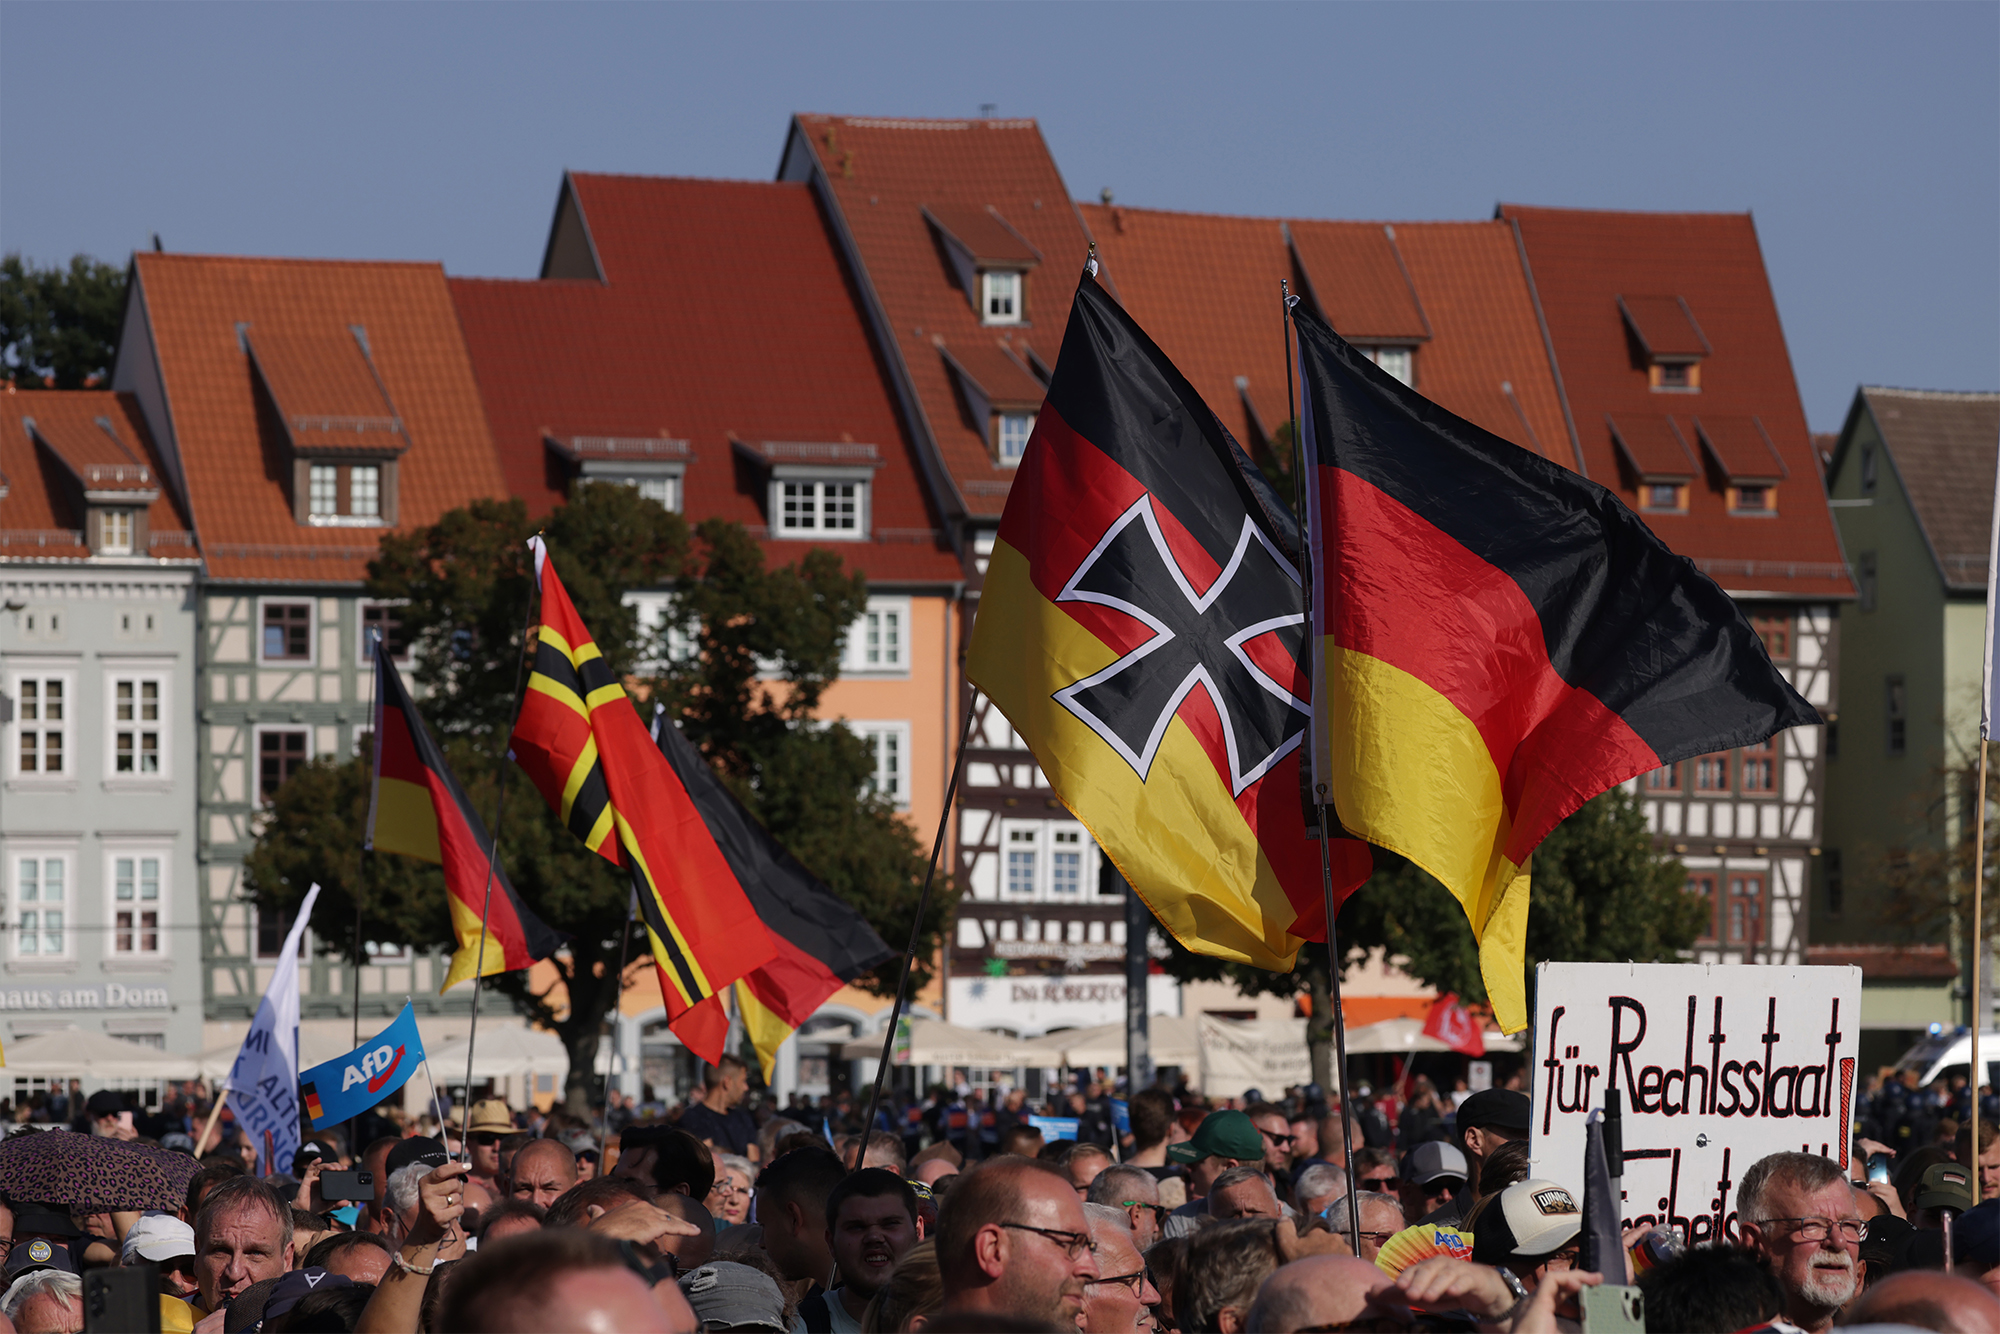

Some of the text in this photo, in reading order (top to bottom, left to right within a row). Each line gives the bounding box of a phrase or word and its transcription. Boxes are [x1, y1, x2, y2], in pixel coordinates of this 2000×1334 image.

[58, 989, 99, 1009] am
[104, 983, 168, 1009] Dom
[341, 1044, 394, 1093] AfD
[1543, 1005, 1600, 1136] für
[257, 1074, 300, 1143] ALTE
[1537, 1190, 1573, 1208] DJINNS
[1434, 1230, 1465, 1250] AfD
